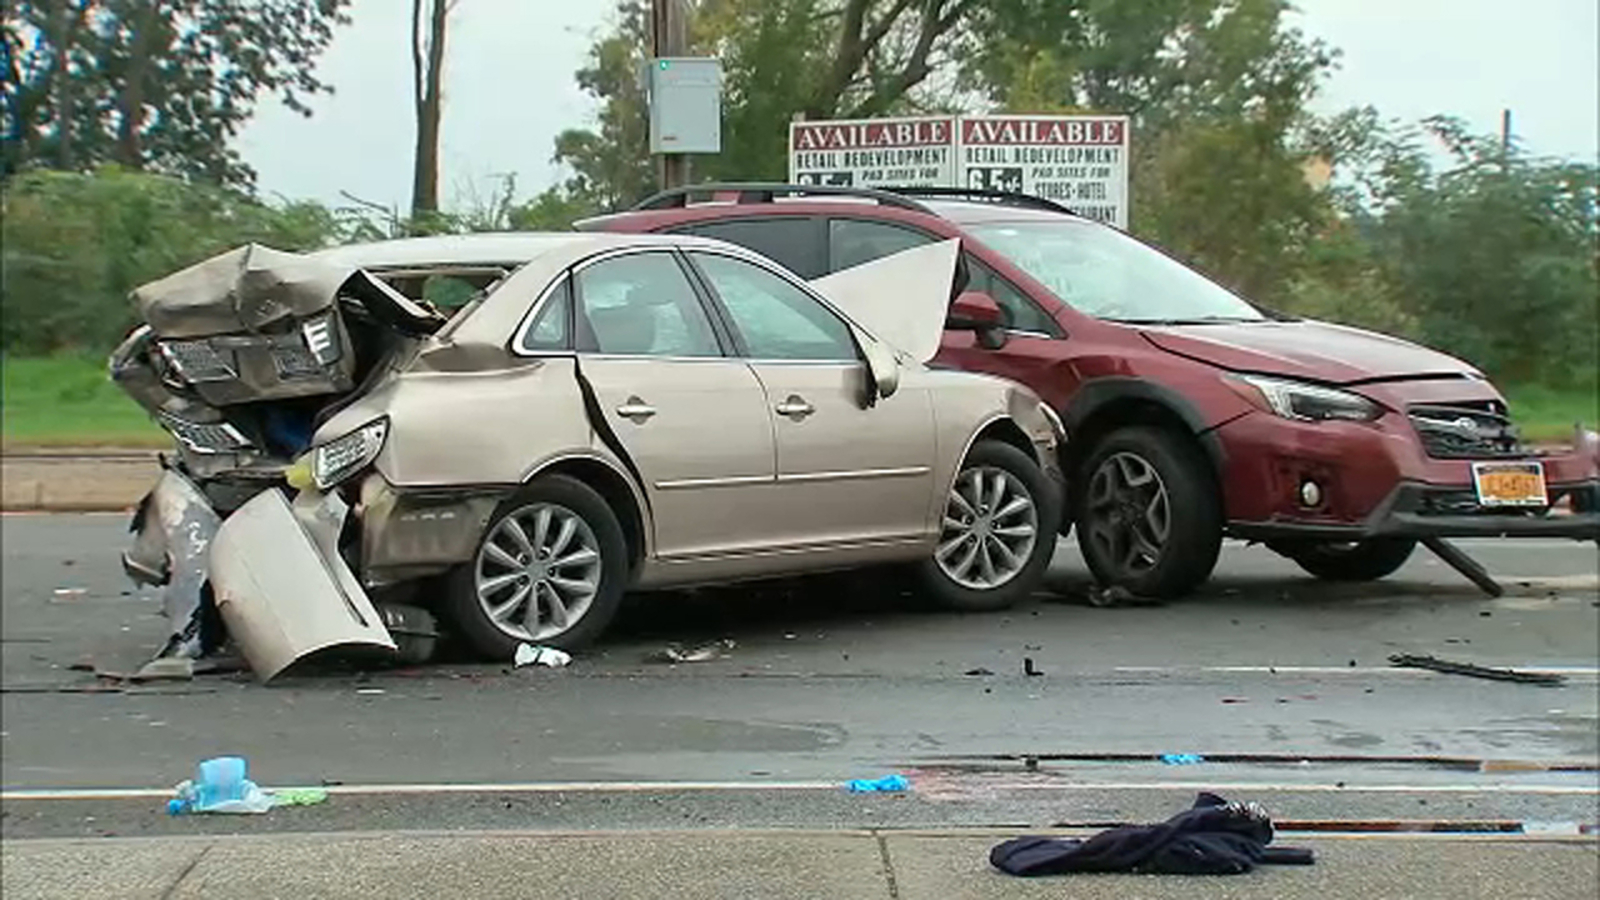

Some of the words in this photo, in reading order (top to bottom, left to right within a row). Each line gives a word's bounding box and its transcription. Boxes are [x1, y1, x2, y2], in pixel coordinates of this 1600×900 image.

[798, 121, 947, 148] AVAILABLE
[967, 121, 1119, 143] AVAILABLE
[797, 151, 836, 168] RETAIL
[844, 148, 947, 167] REDEVELOPMENT
[966, 148, 1007, 163] RETAIL
[1014, 148, 1119, 163] REDEVELOPMENT
[919, 167, 939, 179] FOR
[1090, 167, 1110, 178] FOR
